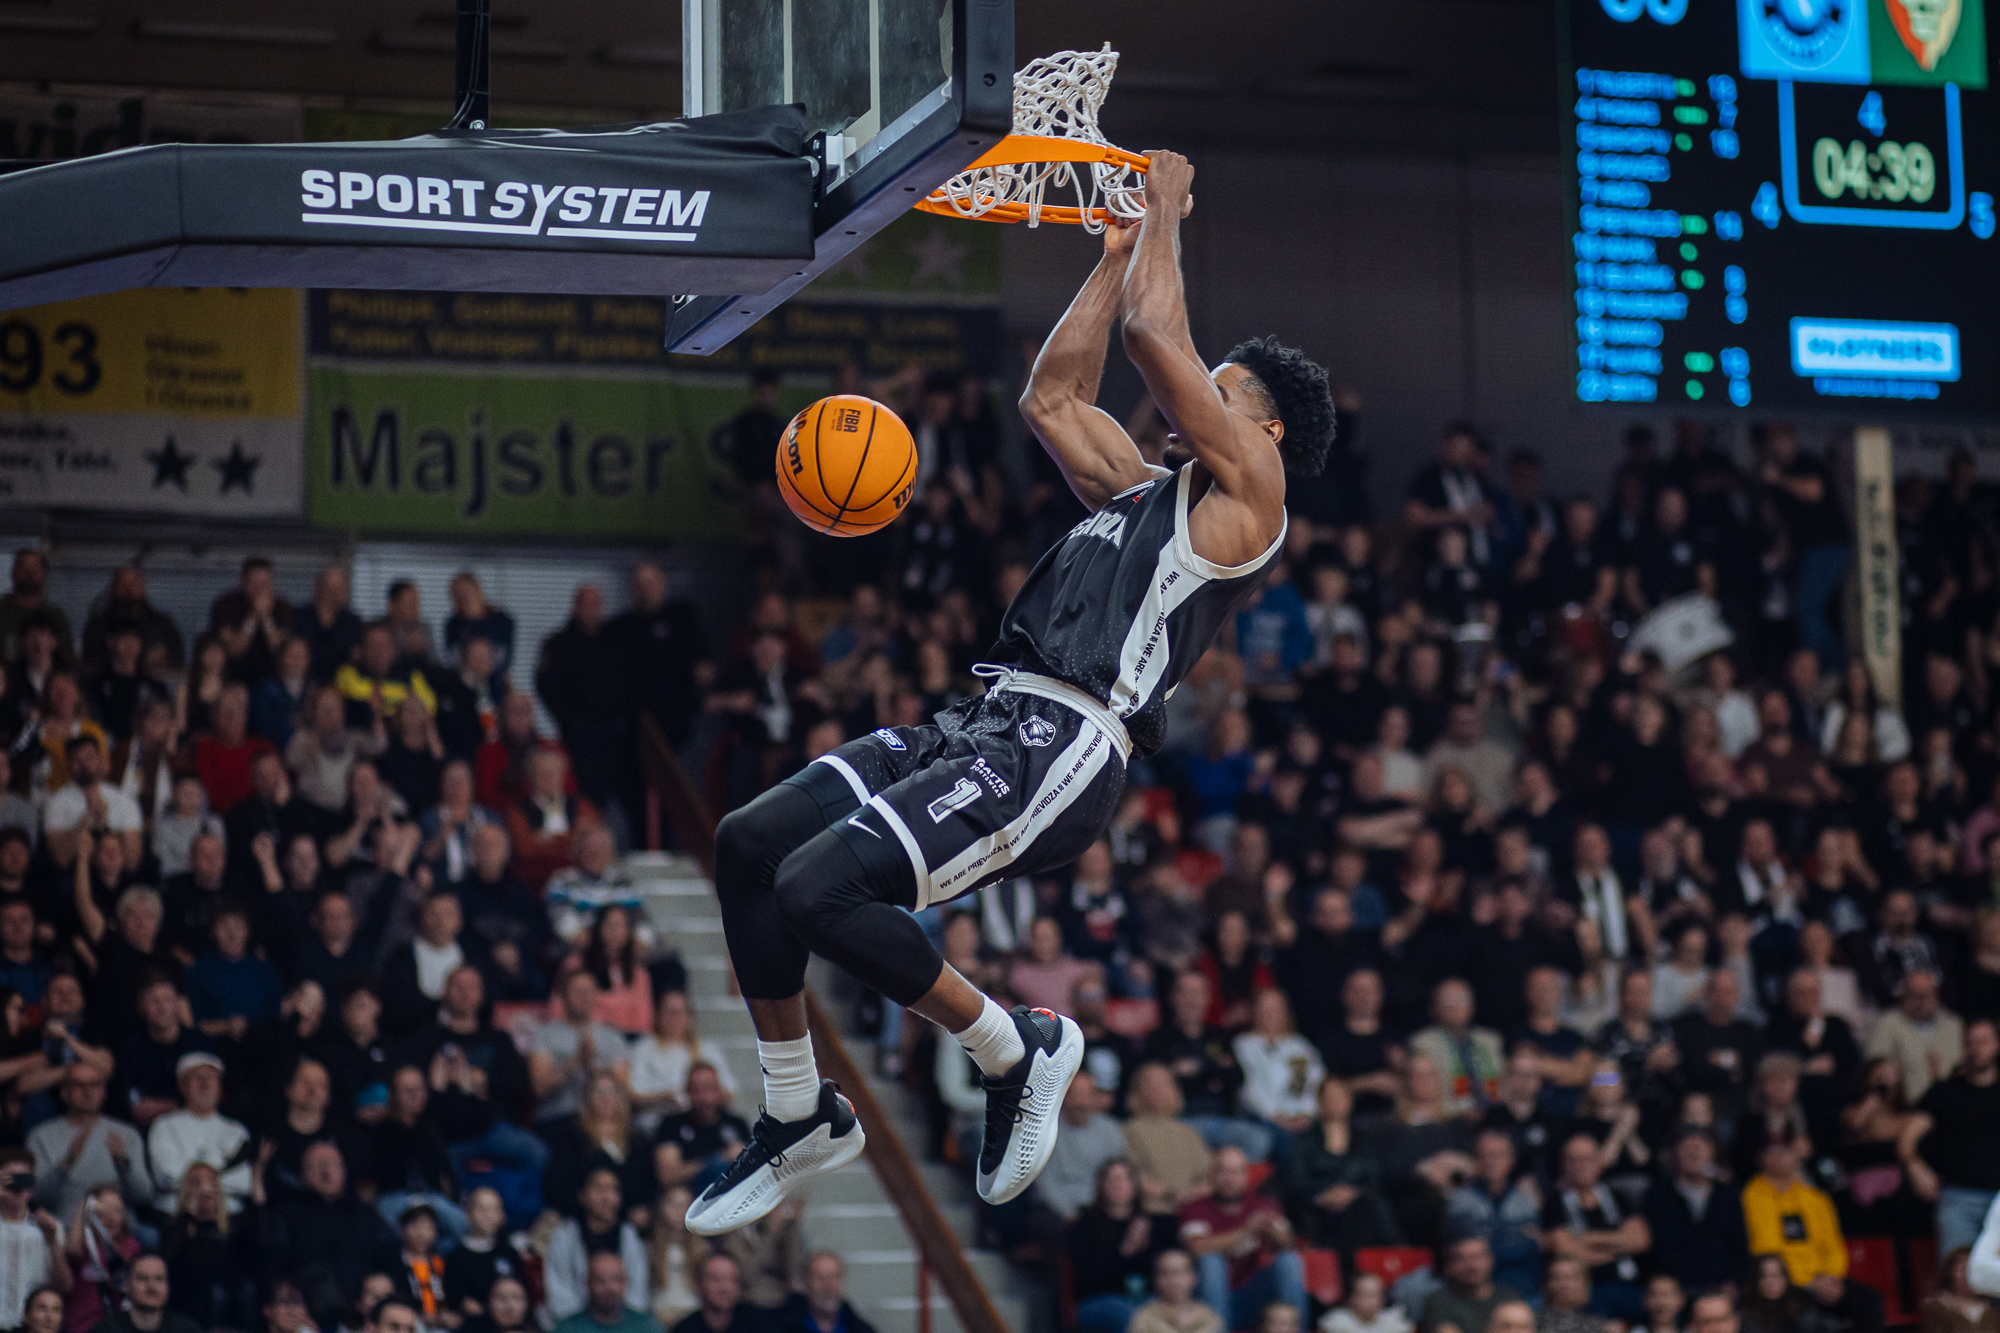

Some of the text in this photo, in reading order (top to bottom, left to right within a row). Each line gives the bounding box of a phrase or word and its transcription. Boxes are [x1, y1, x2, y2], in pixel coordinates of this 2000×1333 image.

[1857, 91, 1887, 137] 4
[1812, 137, 1936, 204] 04:39
[301, 169, 711, 236] SPORT SYSTEM
[1751, 181, 1782, 229] 4
[843, 408, 861, 433] FIBA
[331, 404, 675, 518] Majster
[1164, 570, 1180, 586] WE
[1134, 658, 1148, 675] ARE
[1143, 642, 1156, 658] WE
[1061, 729, 1103, 787] WE ARE PRIEVID
[927, 777, 983, 825] 1
[970, 764, 1003, 799] ORTSWEAR
[1010, 833, 1021, 848] WE
[940, 878, 953, 889] WE
[953, 868, 967, 882] ARE
